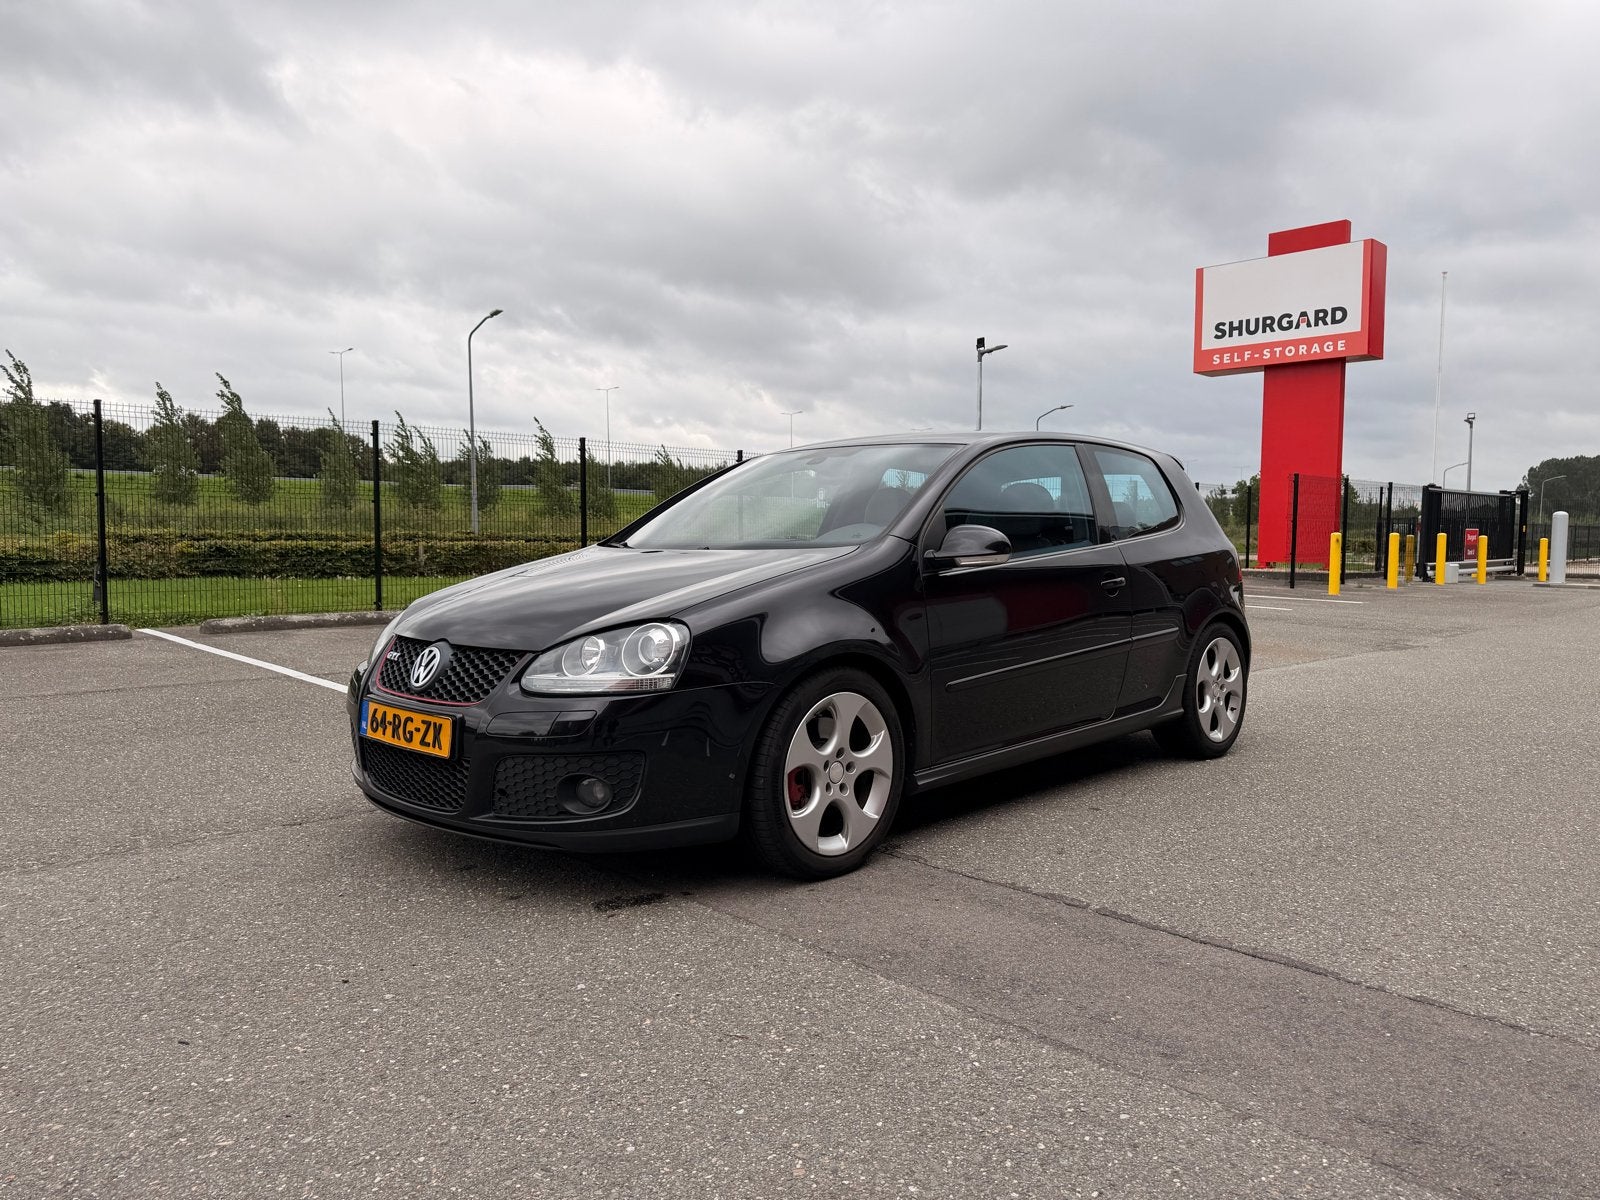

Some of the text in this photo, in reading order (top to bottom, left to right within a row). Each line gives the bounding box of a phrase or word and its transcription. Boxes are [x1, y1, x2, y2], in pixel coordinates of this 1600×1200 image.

[1213, 306, 1348, 340] SHURGARD
[1212, 340, 1346, 365] SELF-STORAGE
[369, 708, 443, 750] 64-RG-ZK
